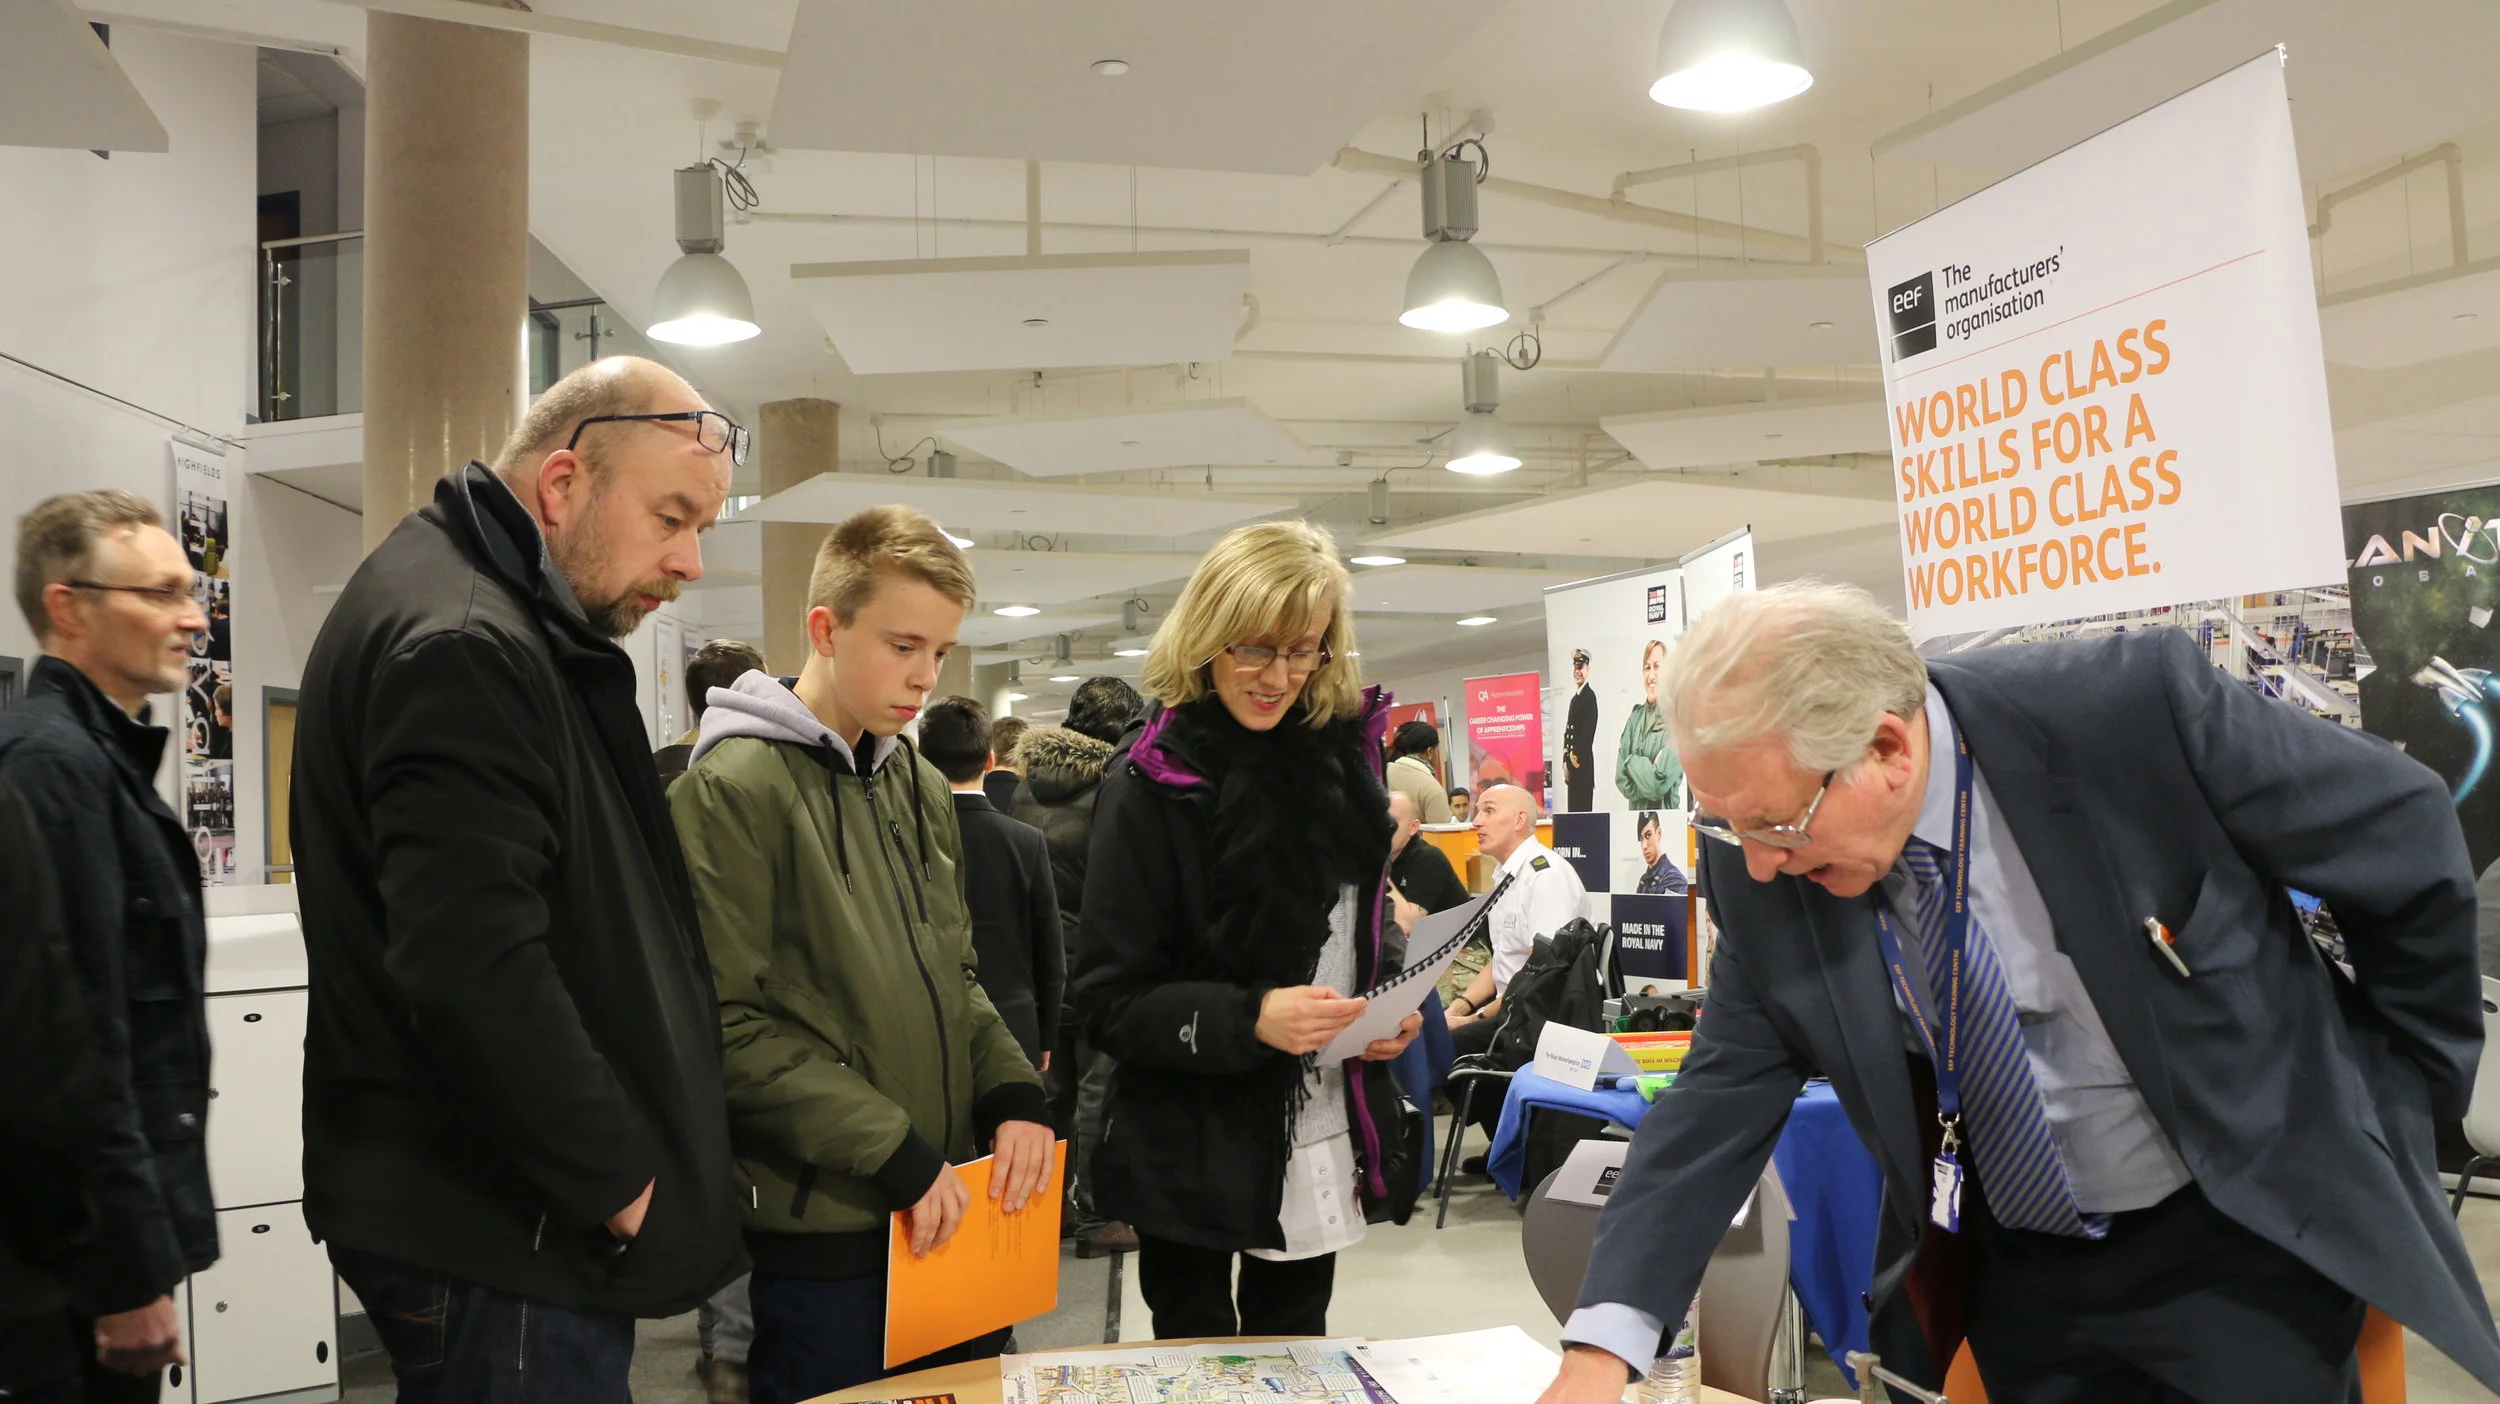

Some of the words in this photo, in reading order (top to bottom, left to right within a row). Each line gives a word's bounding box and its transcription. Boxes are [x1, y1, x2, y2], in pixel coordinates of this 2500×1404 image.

[1942, 264, 1971, 288] The
[1893, 286, 1922, 314] eef
[1946, 289, 2044, 340] organisation
[1896, 369, 2028, 447] WORLD
[2039, 319, 2170, 406] CLASS
[1901, 428, 2020, 503] SKILLS
[2031, 405, 2113, 471] FOR
[2124, 392, 2156, 448] A
[1904, 486, 2037, 556] WORLD
[2049, 449, 2182, 526] CLASS
[1908, 522, 2161, 610] WORKFORCE.
[1648, 611, 1664, 620] NAVY
[1496, 705, 1506, 713] THE
[1515, 713, 1534, 721] POWER
[1956, 854, 1964, 900] TECHNOLOGY
[1622, 923, 1643, 935] MADE
[1644, 925, 1651, 936] IN
[1652, 925, 1665, 936] THE
[1622, 937, 1644, 949] ROYAL
[1645, 939, 1664, 950] NAVY
[1899, 976, 1921, 1017] TECHNOLOGY
[1948, 1011, 1956, 1057] TECHNOLOGY
